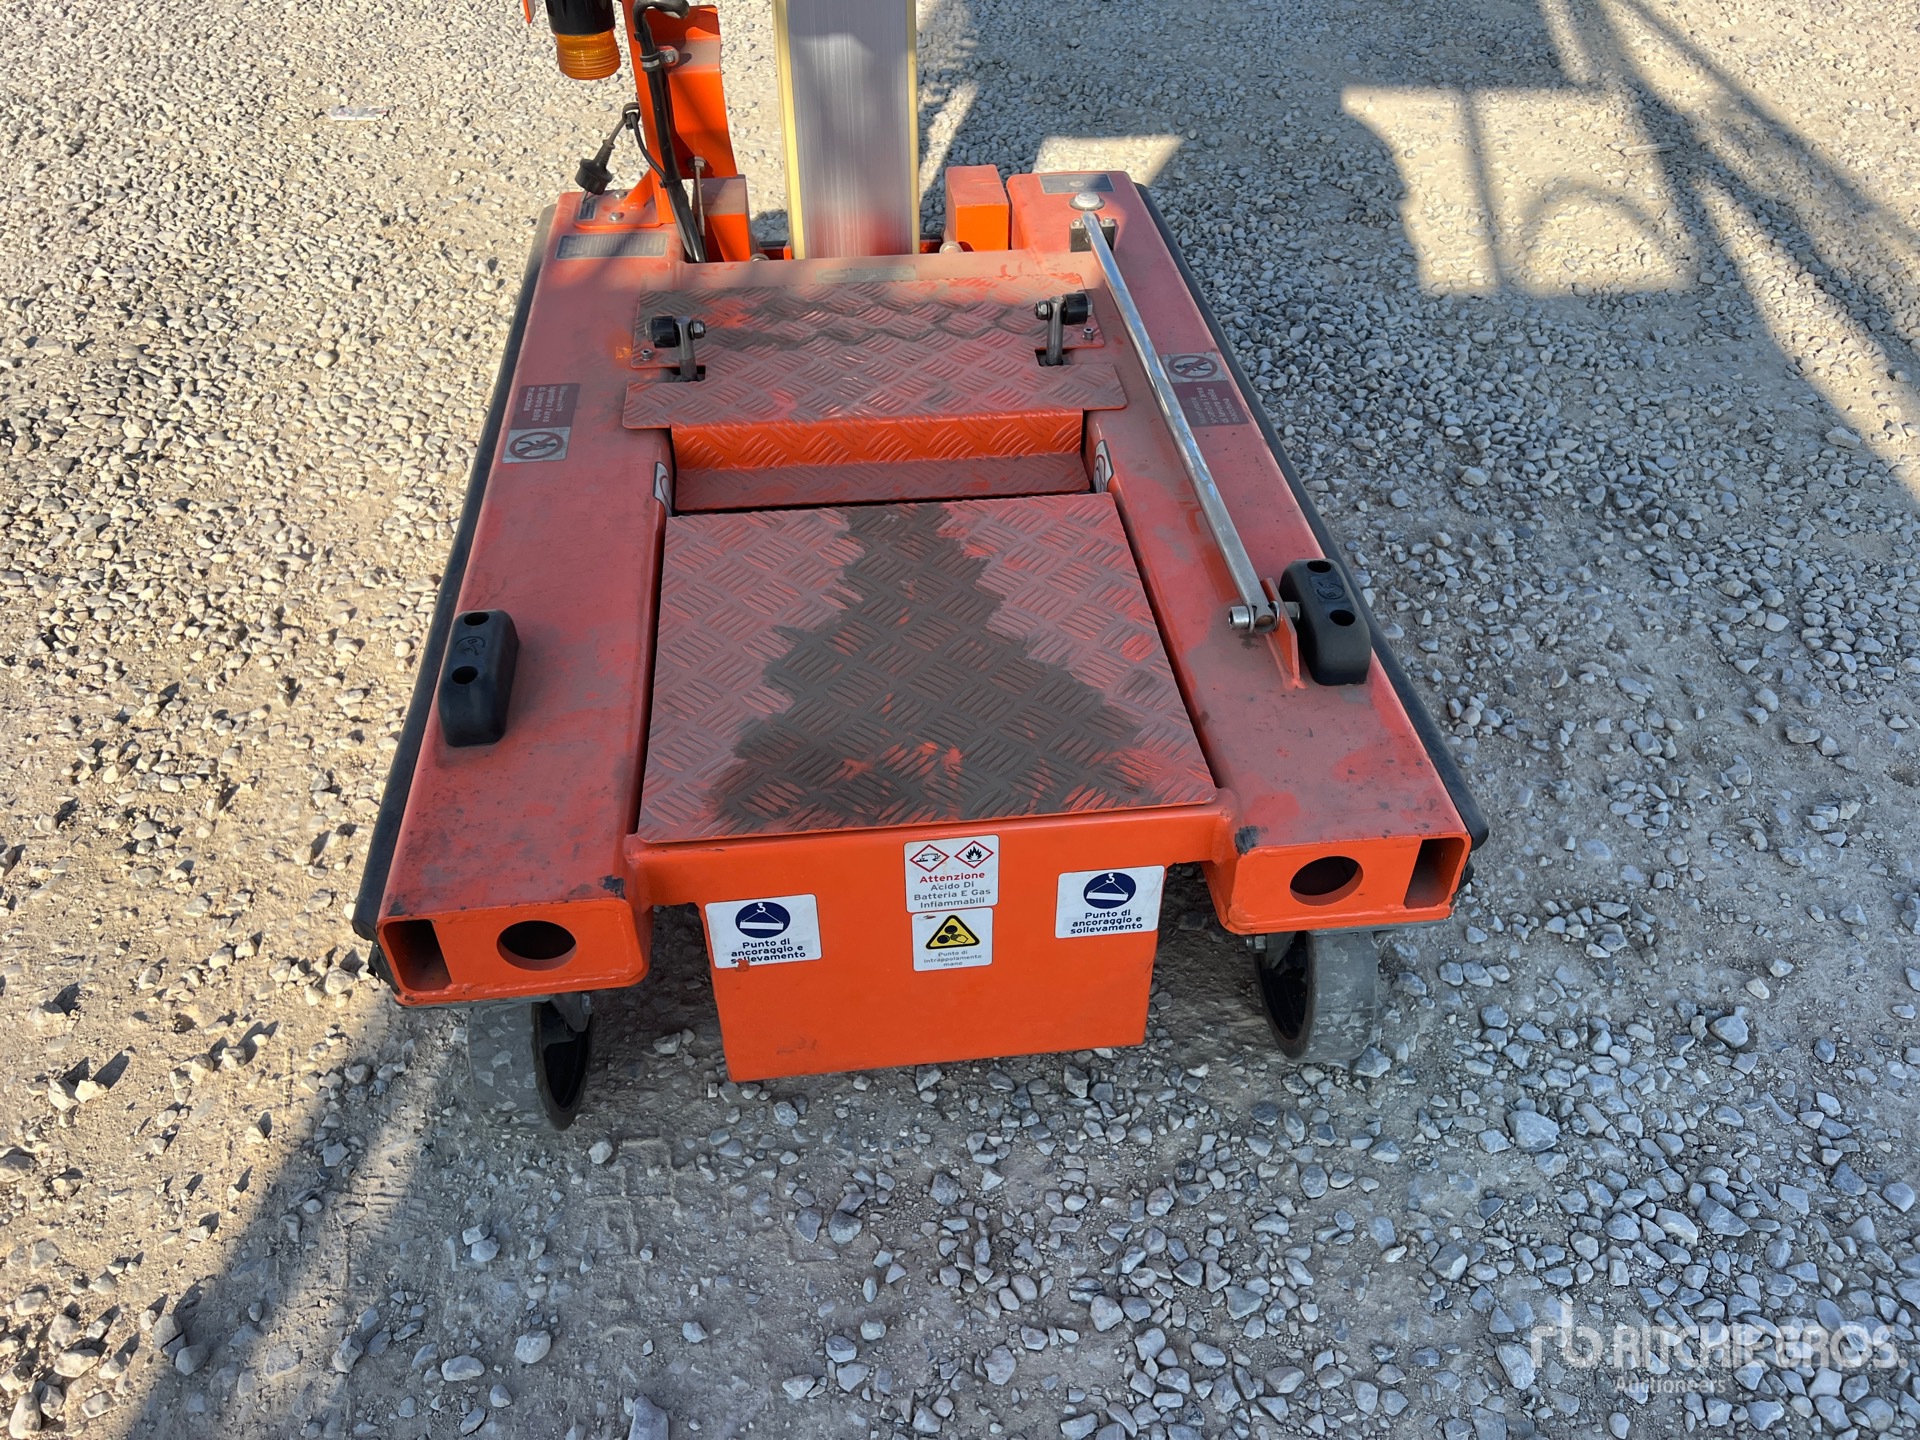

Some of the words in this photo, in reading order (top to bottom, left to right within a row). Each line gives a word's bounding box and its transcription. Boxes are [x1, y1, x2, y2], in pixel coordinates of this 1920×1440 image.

[919, 872, 986, 884] Attenzione
[930, 883, 960, 891] Acido
[913, 892, 957, 901] Batteria
[920, 897, 985, 909] Infiammabili
[1085, 911, 1118, 919] Punto
[1072, 917, 1132, 928] ancoraggio
[1070, 923, 1143, 934] sollevamento
[742, 940, 777, 949] Punto
[731, 946, 794, 957] ancoraggio
